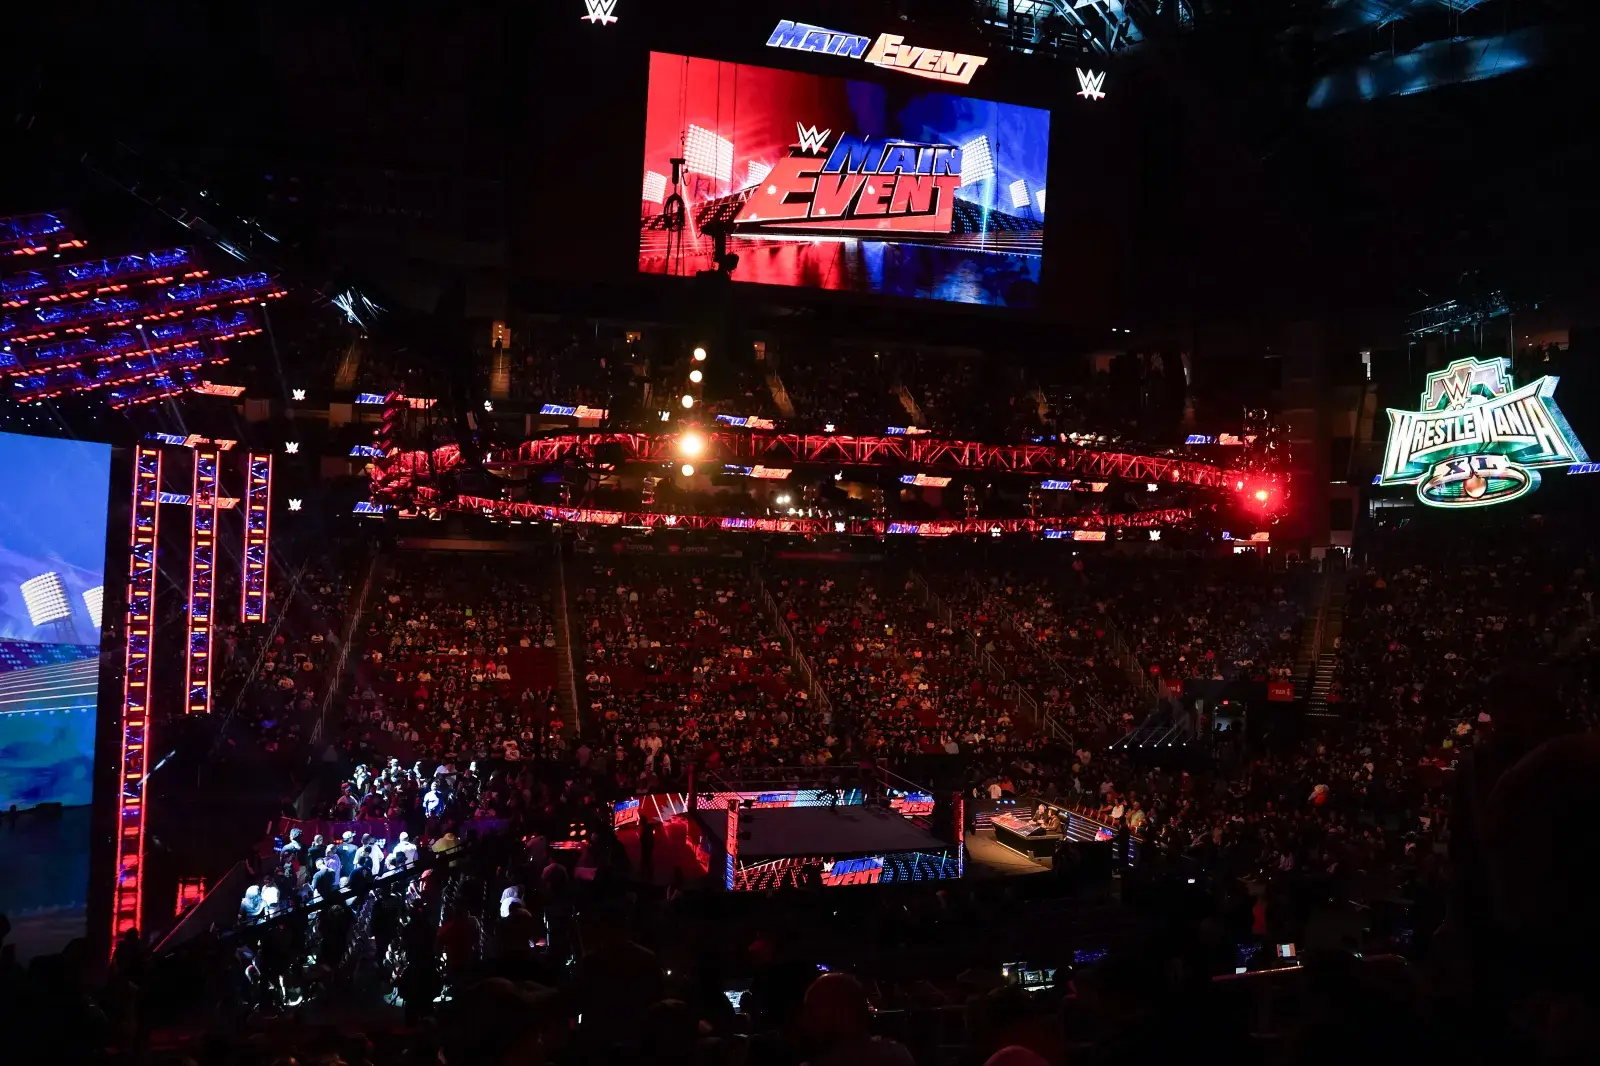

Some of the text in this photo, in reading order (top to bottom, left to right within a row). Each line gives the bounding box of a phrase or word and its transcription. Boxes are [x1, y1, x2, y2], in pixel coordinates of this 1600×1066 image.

[765, 19, 989, 85] MAIN EVENT
[823, 131, 962, 176] MAIN
[733, 157, 962, 234] EVENT
[1443, 456, 1498, 480] XL
[158, 491, 191, 505] AIN
[831, 857, 885, 878] MAIN
